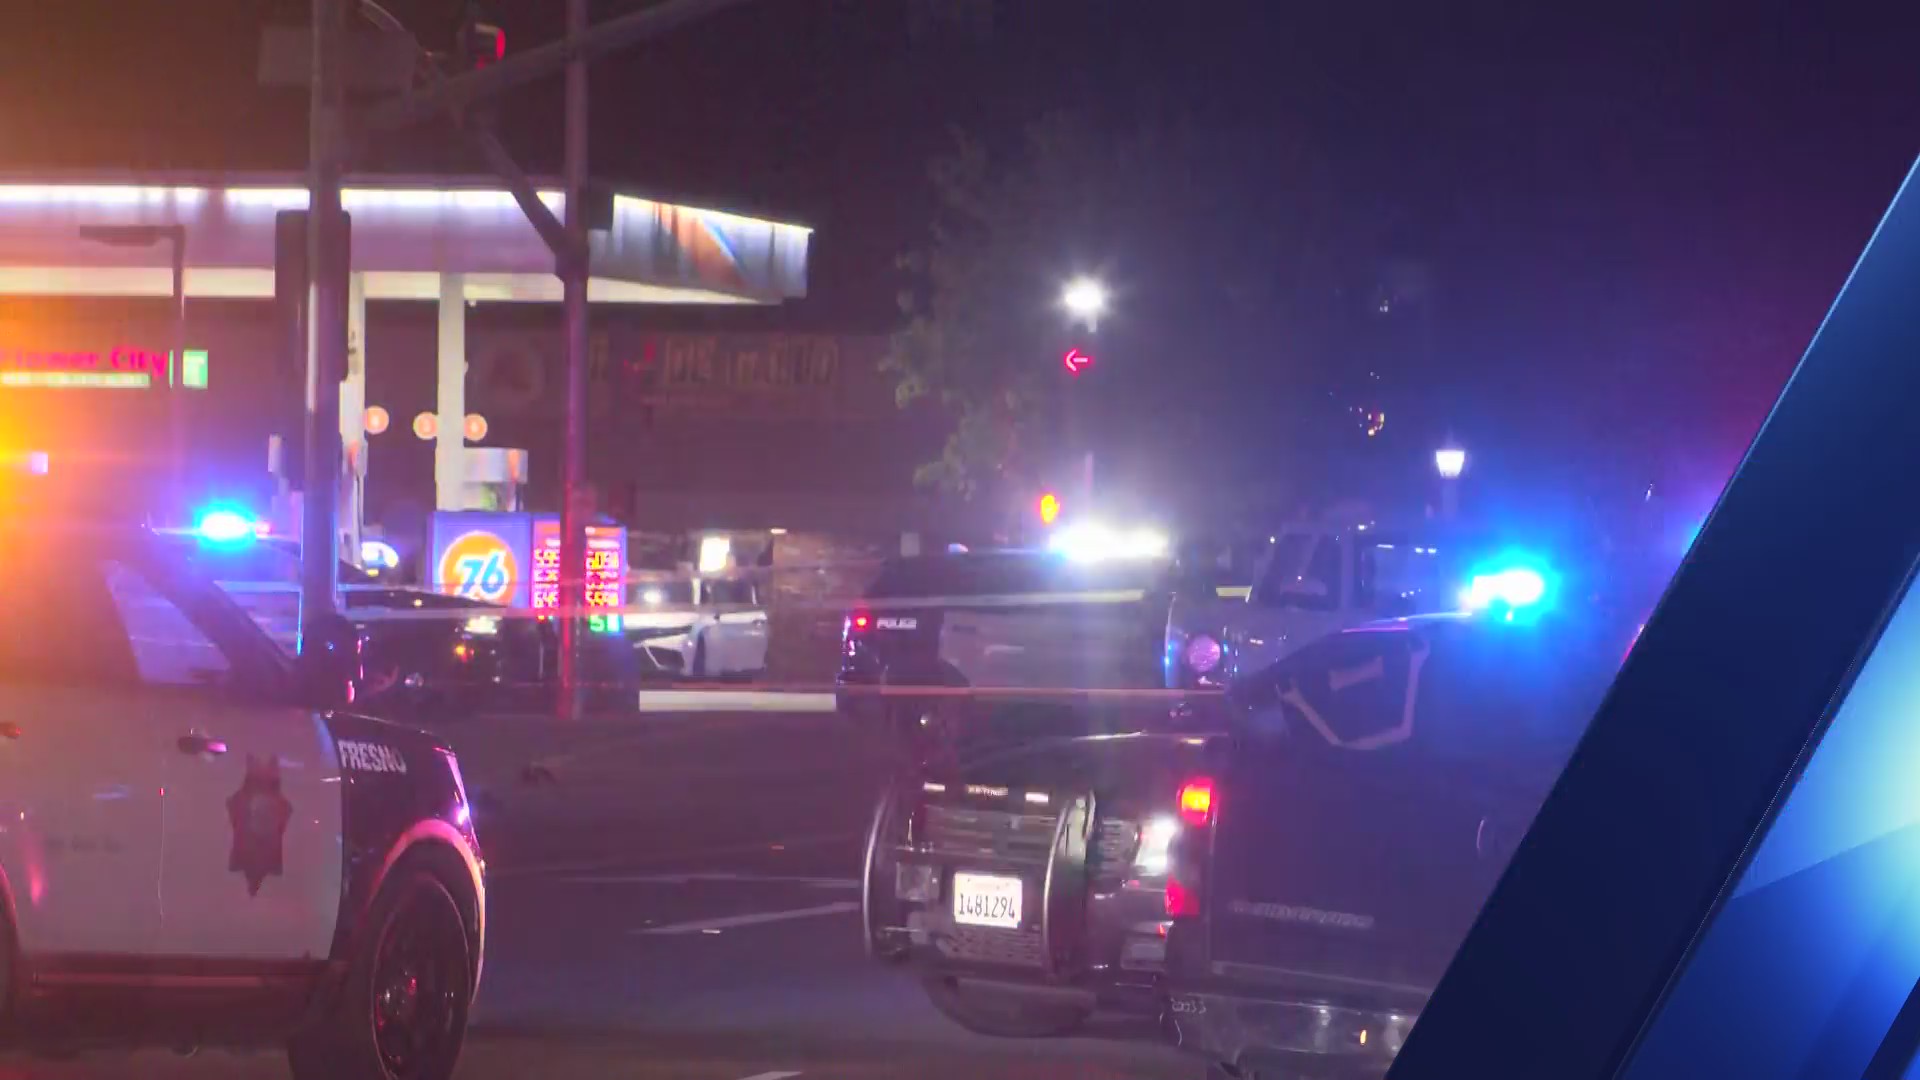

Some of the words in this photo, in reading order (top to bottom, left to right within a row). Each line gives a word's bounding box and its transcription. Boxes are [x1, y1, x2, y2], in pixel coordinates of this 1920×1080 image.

[456, 549, 509, 600] 76
[877, 618, 917, 629] POLICE
[338, 740, 406, 773] FRESNO
[958, 893, 1016, 919] 1481294
